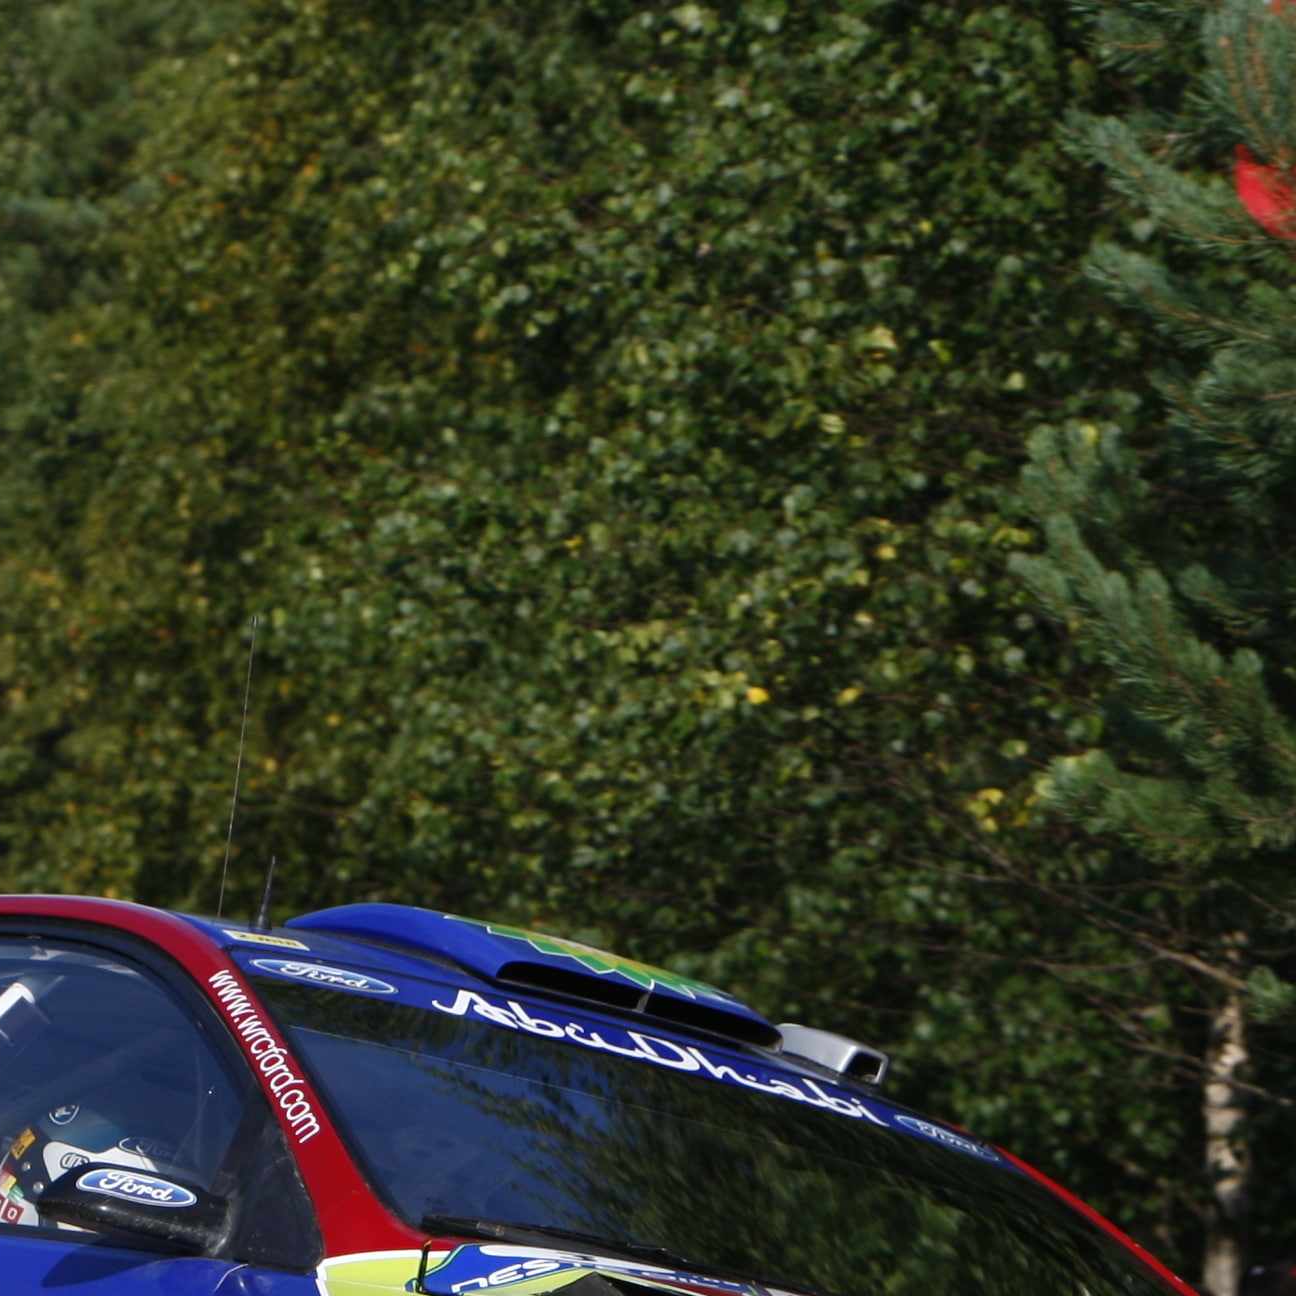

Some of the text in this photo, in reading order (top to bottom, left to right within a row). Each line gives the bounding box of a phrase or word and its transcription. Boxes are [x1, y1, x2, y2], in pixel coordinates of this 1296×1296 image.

[280, 963, 371, 989] Ford
[208, 969, 321, 1145] www.wrcford.com
[99, 1172, 174, 1202] Ford
